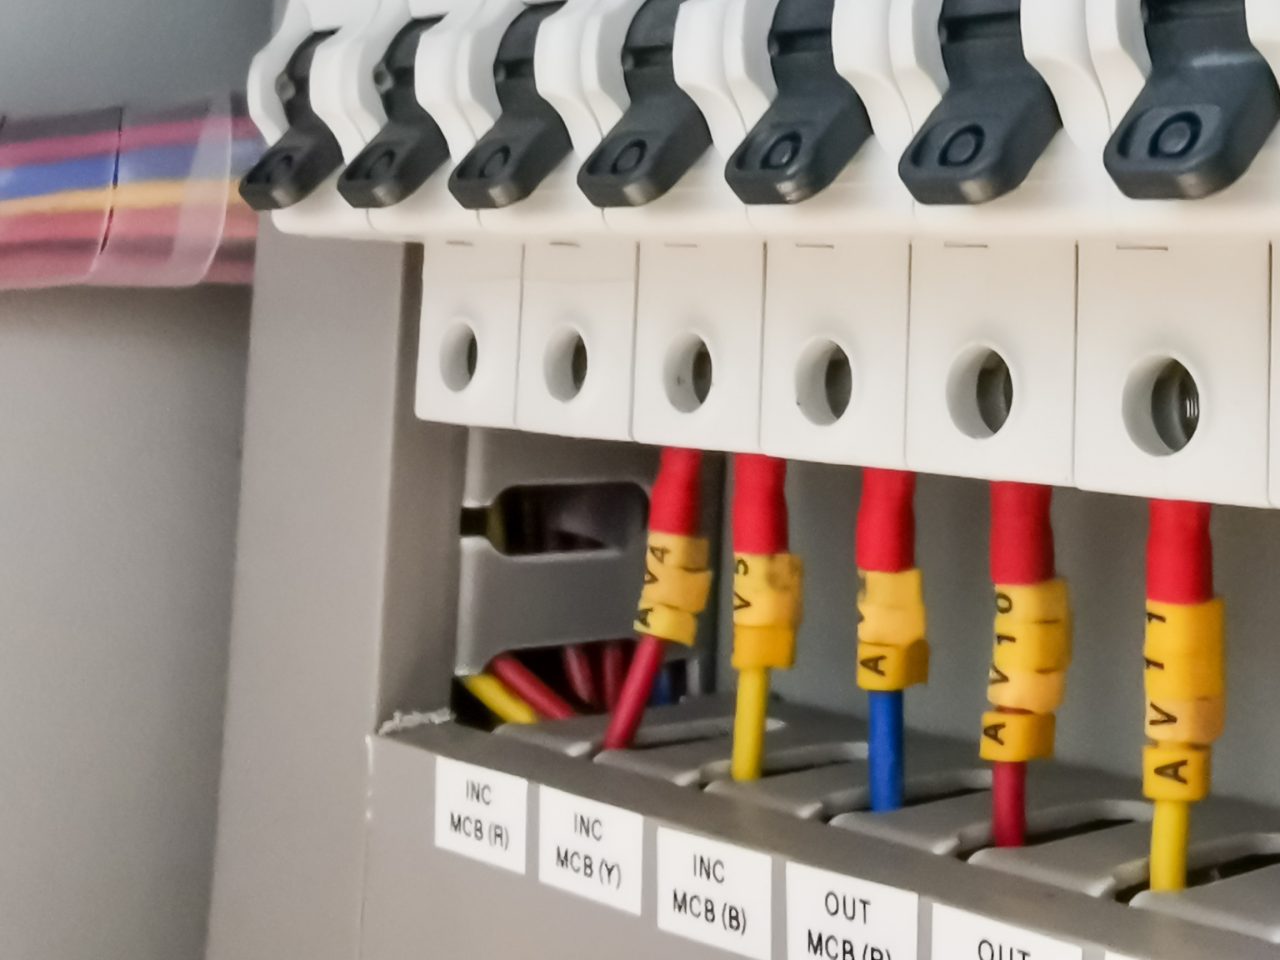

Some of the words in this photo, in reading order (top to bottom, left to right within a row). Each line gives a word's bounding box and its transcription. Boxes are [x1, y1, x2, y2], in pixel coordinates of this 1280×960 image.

[466, 780, 491, 806] INC
[450, 811, 483, 841] MCB
[574, 814, 603, 841] INC
[556, 846, 593, 878] MCB
[599, 863, 622, 890] (Y)
[694, 854, 725, 884] INC
[673, 889, 715, 922] MCB
[722, 905, 747, 936] (B)
[825, 891, 871, 924] OUT
